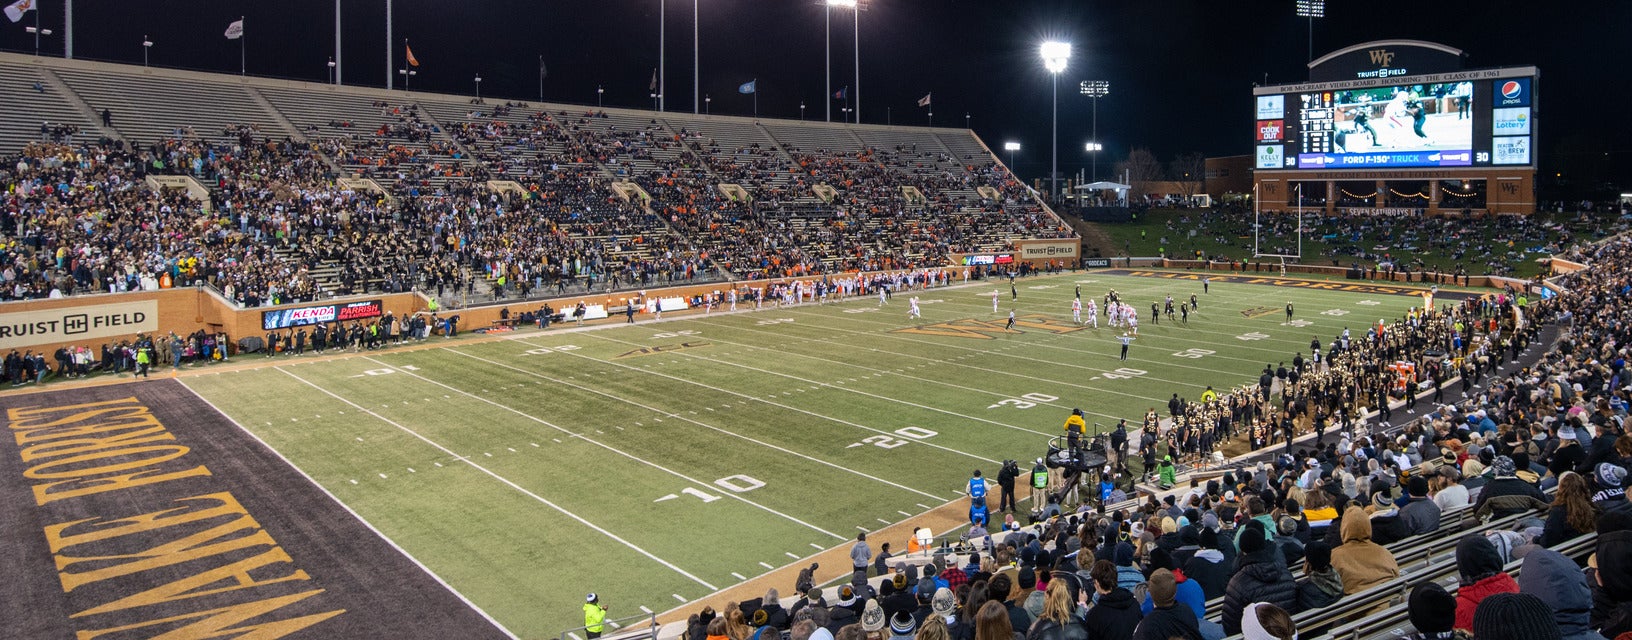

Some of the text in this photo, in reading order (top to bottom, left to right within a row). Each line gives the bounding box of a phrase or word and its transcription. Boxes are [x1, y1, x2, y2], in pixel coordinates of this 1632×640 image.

[1369, 49, 1395, 67] WF
[1353, 79, 1376, 87] BOARD
[1381, 76, 1421, 85] HONORING
[1443, 73, 1467, 81] CLASS
[1483, 70, 1500, 78] 1961
[1357, 68, 1406, 78] TRUIST FIELD
[1260, 126, 1280, 134] COOK
[1496, 122, 1525, 130] Lottery
[1286, 157, 1296, 166] 30
[1343, 156, 1364, 164] FORD
[1476, 152, 1489, 162] 30
[1264, 183, 1277, 195] WF
[1501, 182, 1519, 194] WF
[1349, 208, 1370, 217] SEVEN
[1371, 207, 1409, 217] SATURDAYS
[292, 306, 334, 319] KENDA
[340, 304, 378, 316] PARRISH
[93, 312, 146, 328] FIELD
[1172, 348, 1216, 359] 50
[1101, 367, 1148, 380] 40
[997, 392, 1060, 409] 30
[861, 426, 938, 449] 20
[7, 396, 213, 506] FOREST
[681, 474, 767, 503] 10
[44, 491, 347, 640] WAKE
